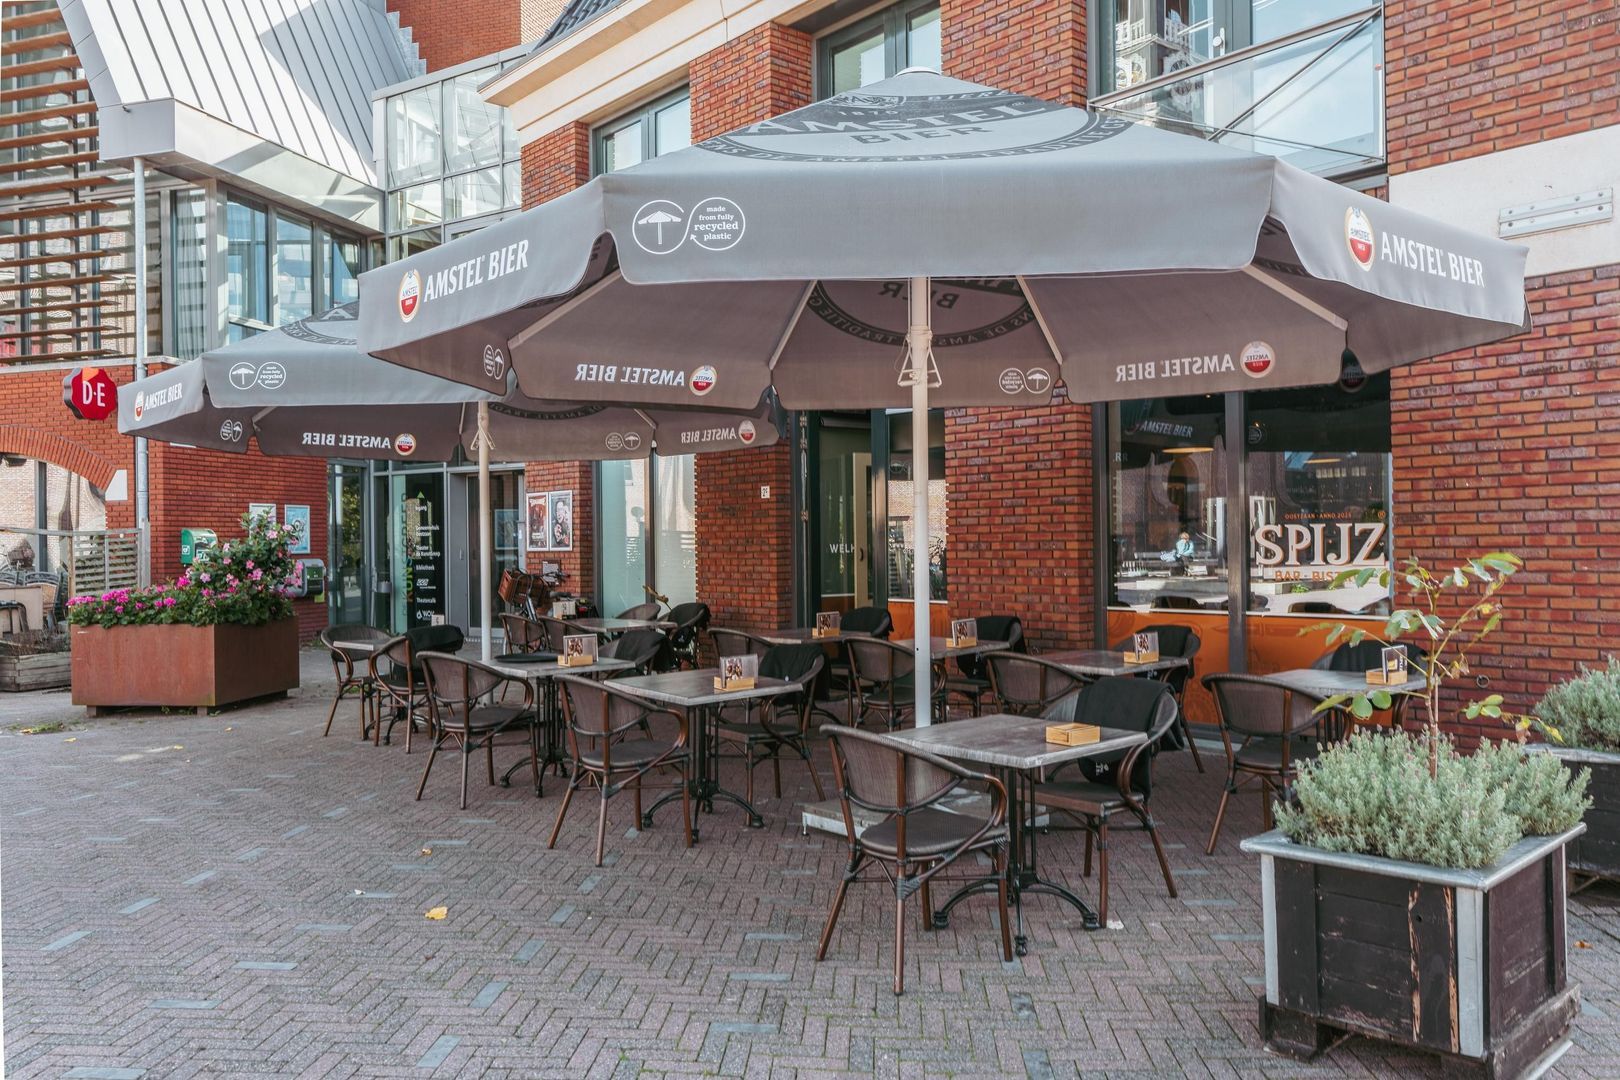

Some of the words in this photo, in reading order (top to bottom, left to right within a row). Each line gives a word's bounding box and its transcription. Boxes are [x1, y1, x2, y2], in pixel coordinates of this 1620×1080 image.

[850, 126, 992, 144] BIER
[706, 205, 726, 213] made
[694, 221, 739, 232] recycled
[703, 232, 732, 241] plastic
[1381, 231, 1447, 277] AMSTEL
[1448, 252, 1485, 288] BIER
[424, 256, 484, 302] AMSTEL
[487, 240, 529, 281] BIER
[144, 389, 167, 411] AMSTEL
[168, 383, 183, 403] BIER
[1255, 522, 1387, 566] SPIJZ
[1275, 571, 1301, 581] BAR
